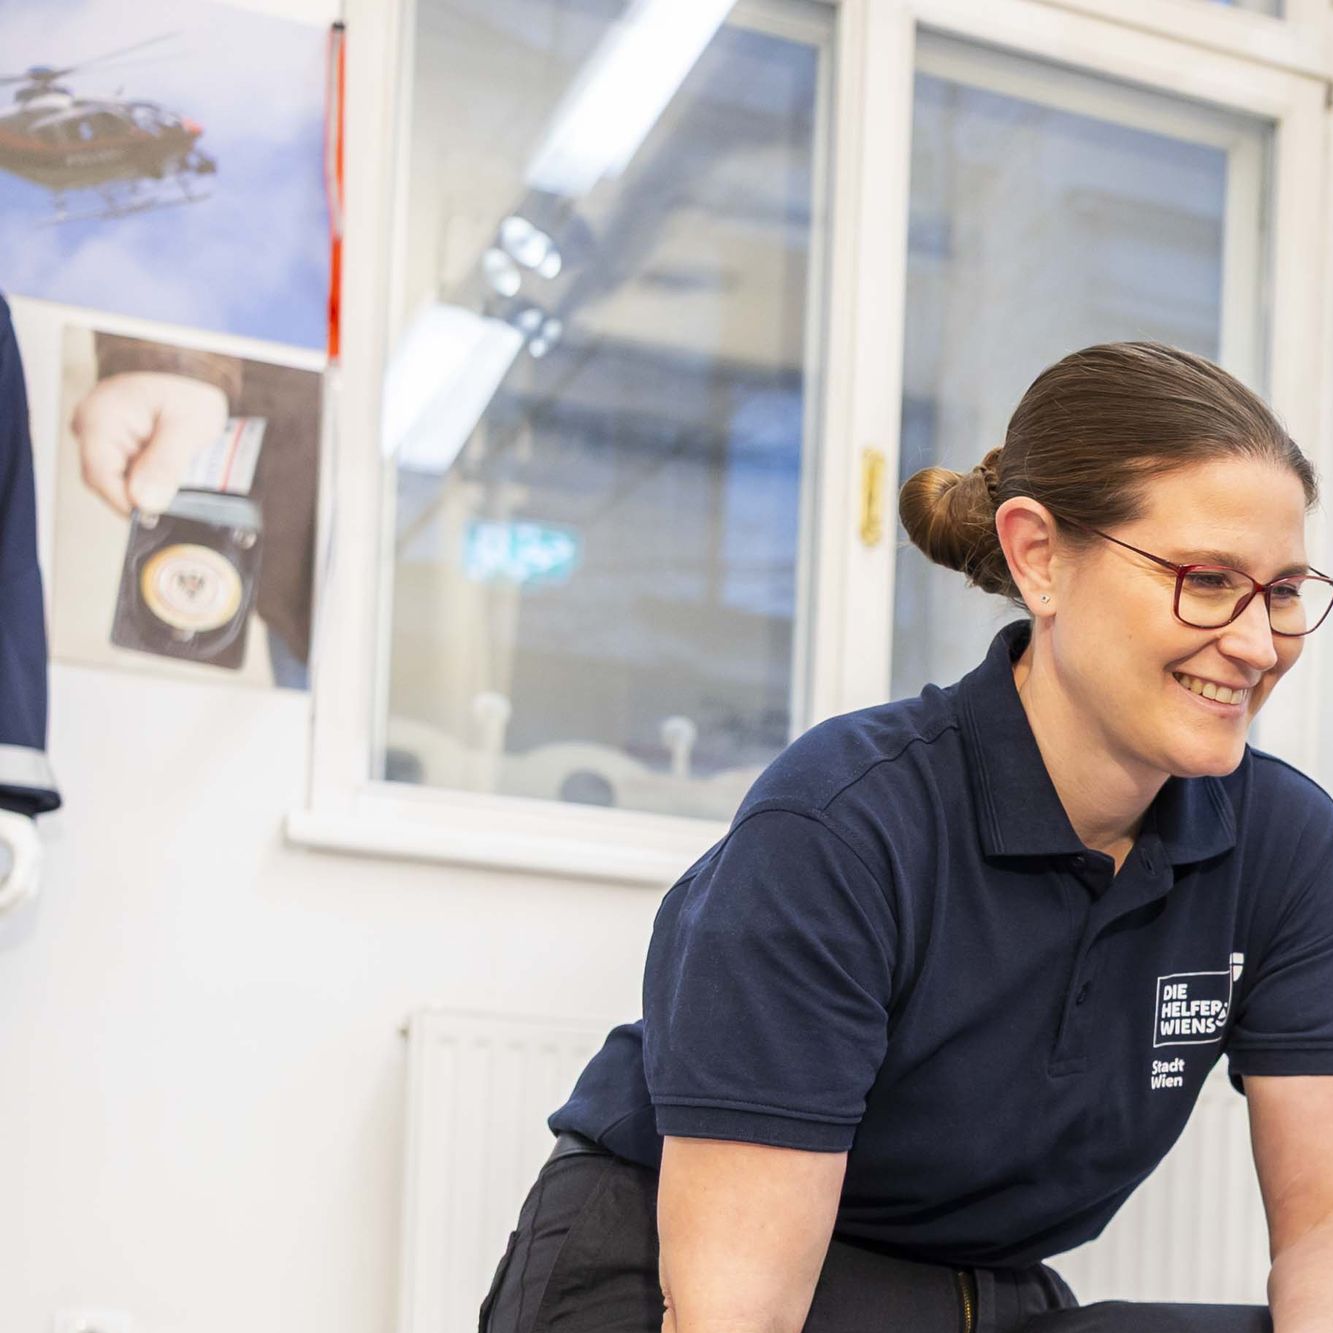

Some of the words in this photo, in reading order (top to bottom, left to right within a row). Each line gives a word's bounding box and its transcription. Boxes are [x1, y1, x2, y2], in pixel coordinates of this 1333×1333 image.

[1163, 983, 1188, 1001] DIE
[1160, 1018, 1216, 1036] WIENS
[1151, 1058, 1185, 1075] Stadt
[1151, 1074, 1183, 1090] Wien
